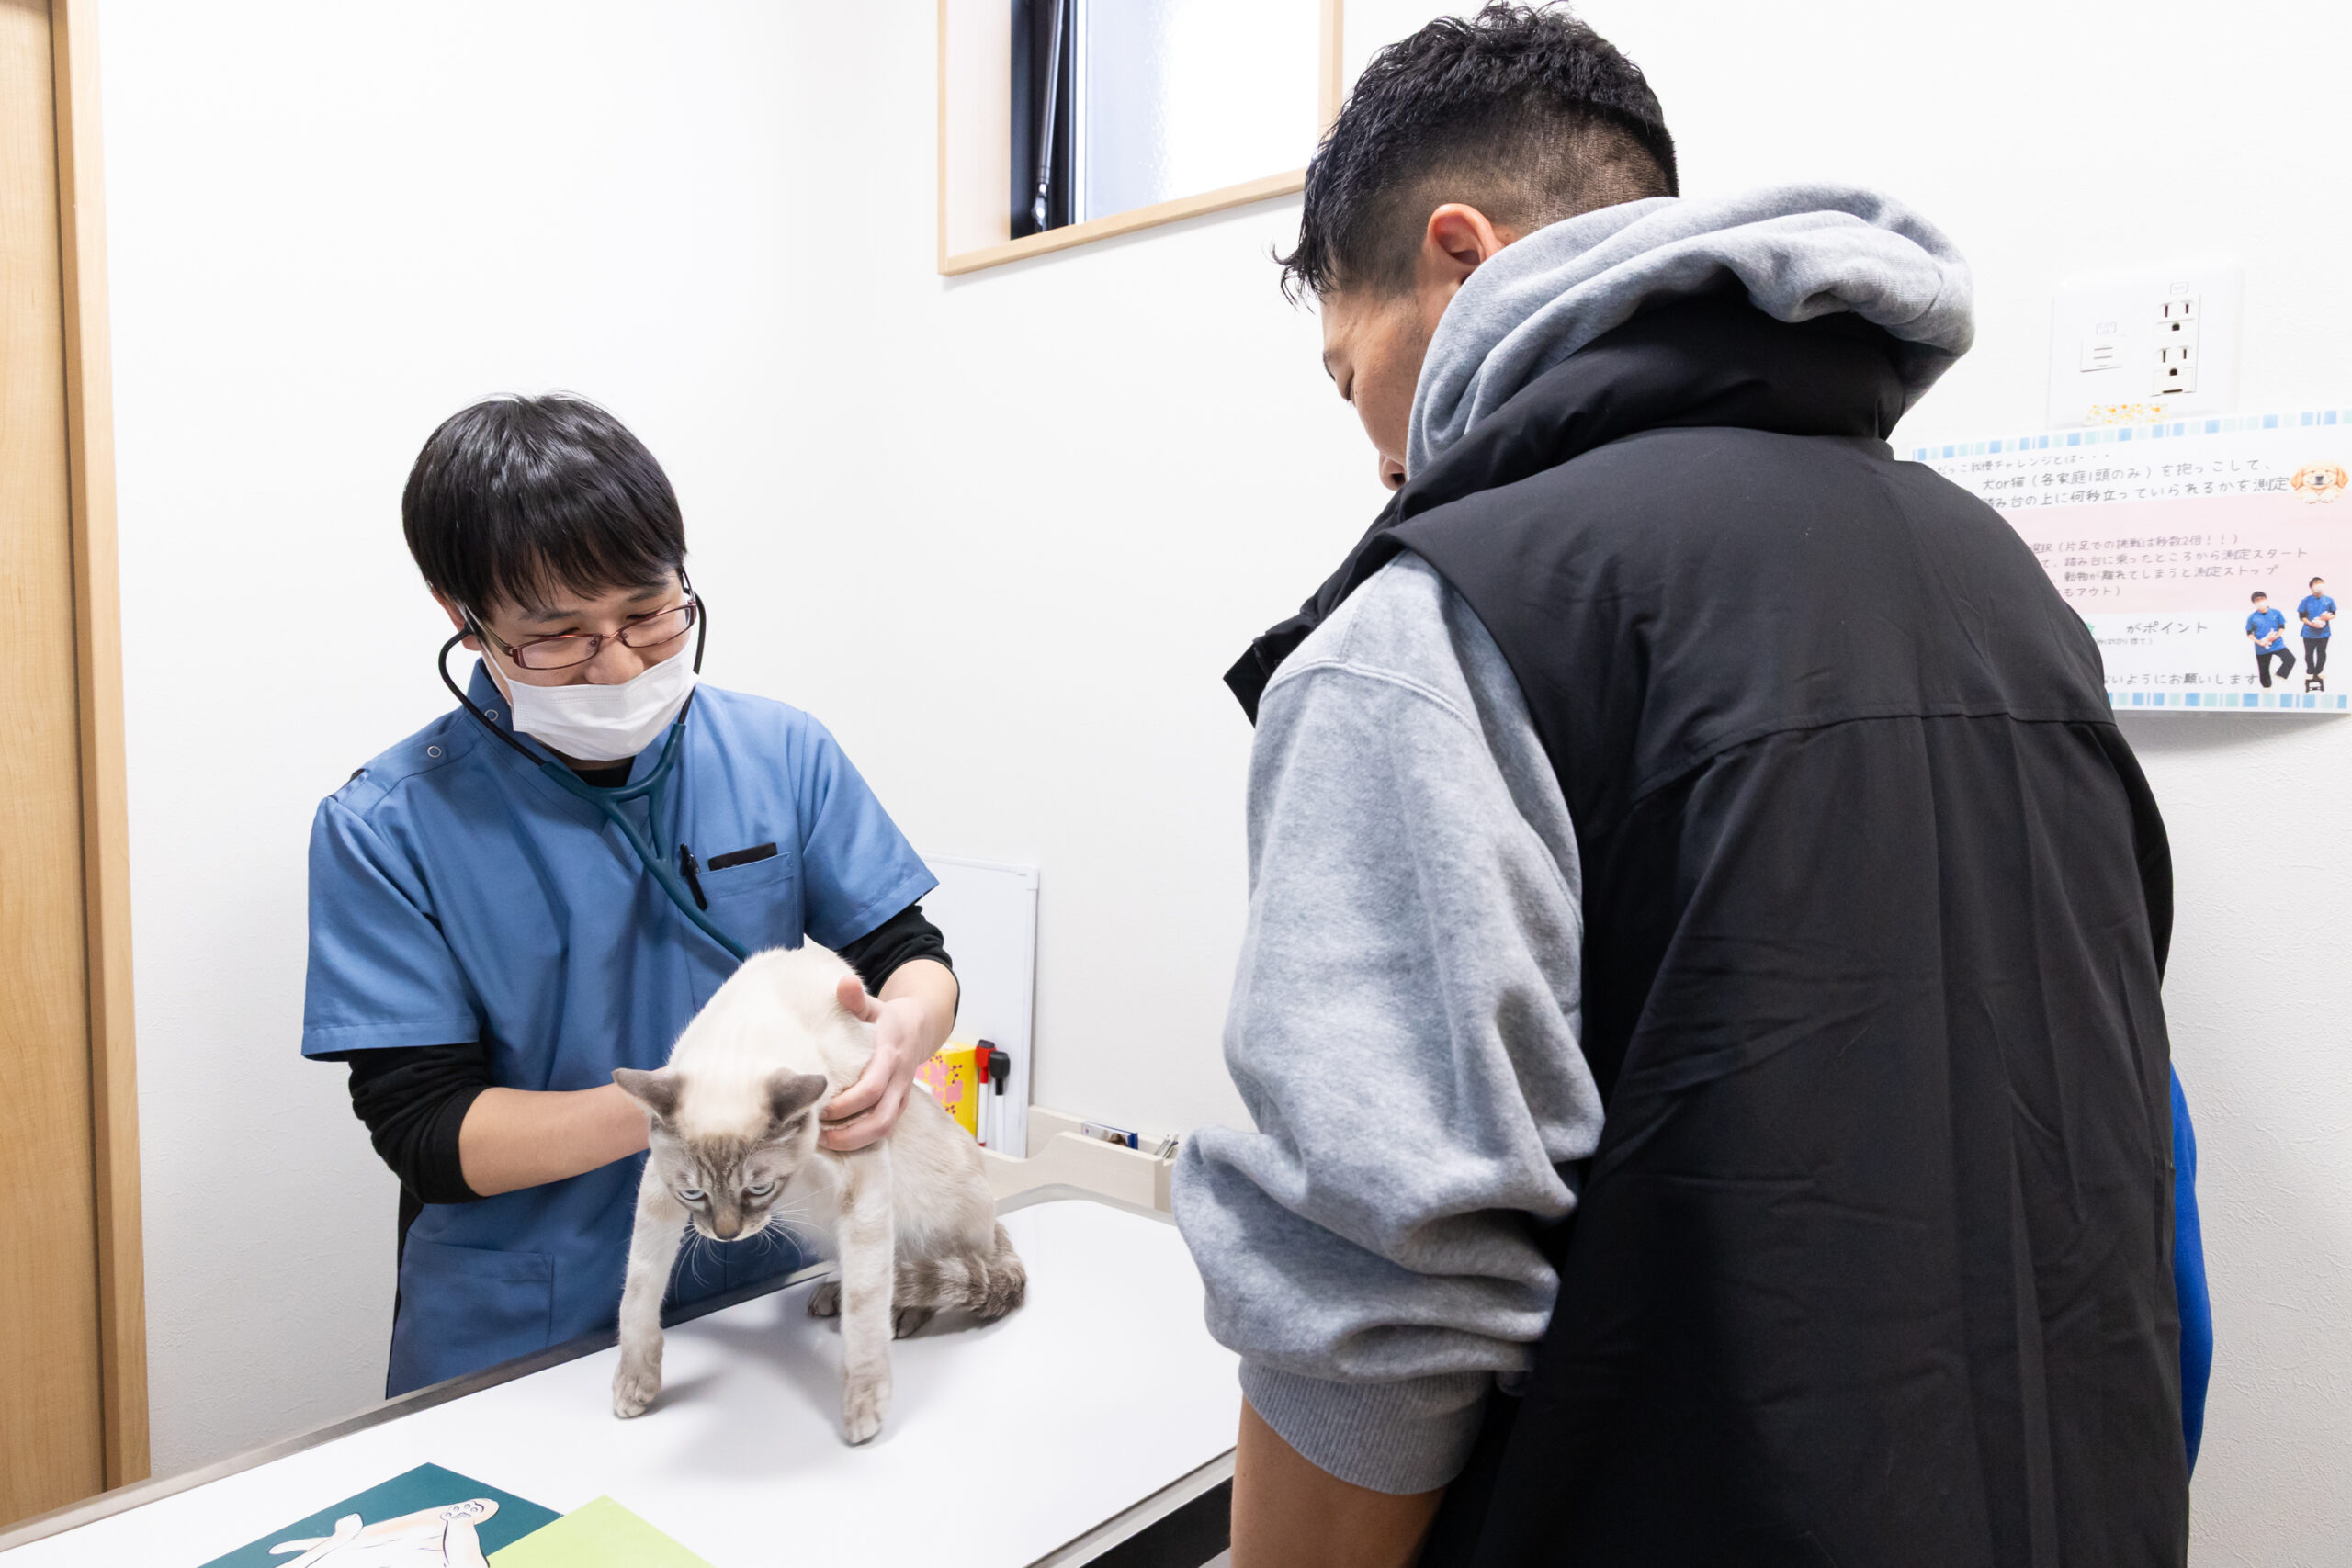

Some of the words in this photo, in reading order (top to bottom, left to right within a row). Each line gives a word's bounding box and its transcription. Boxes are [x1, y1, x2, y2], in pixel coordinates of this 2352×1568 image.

[2126, 620, 2209, 635] がポイント
